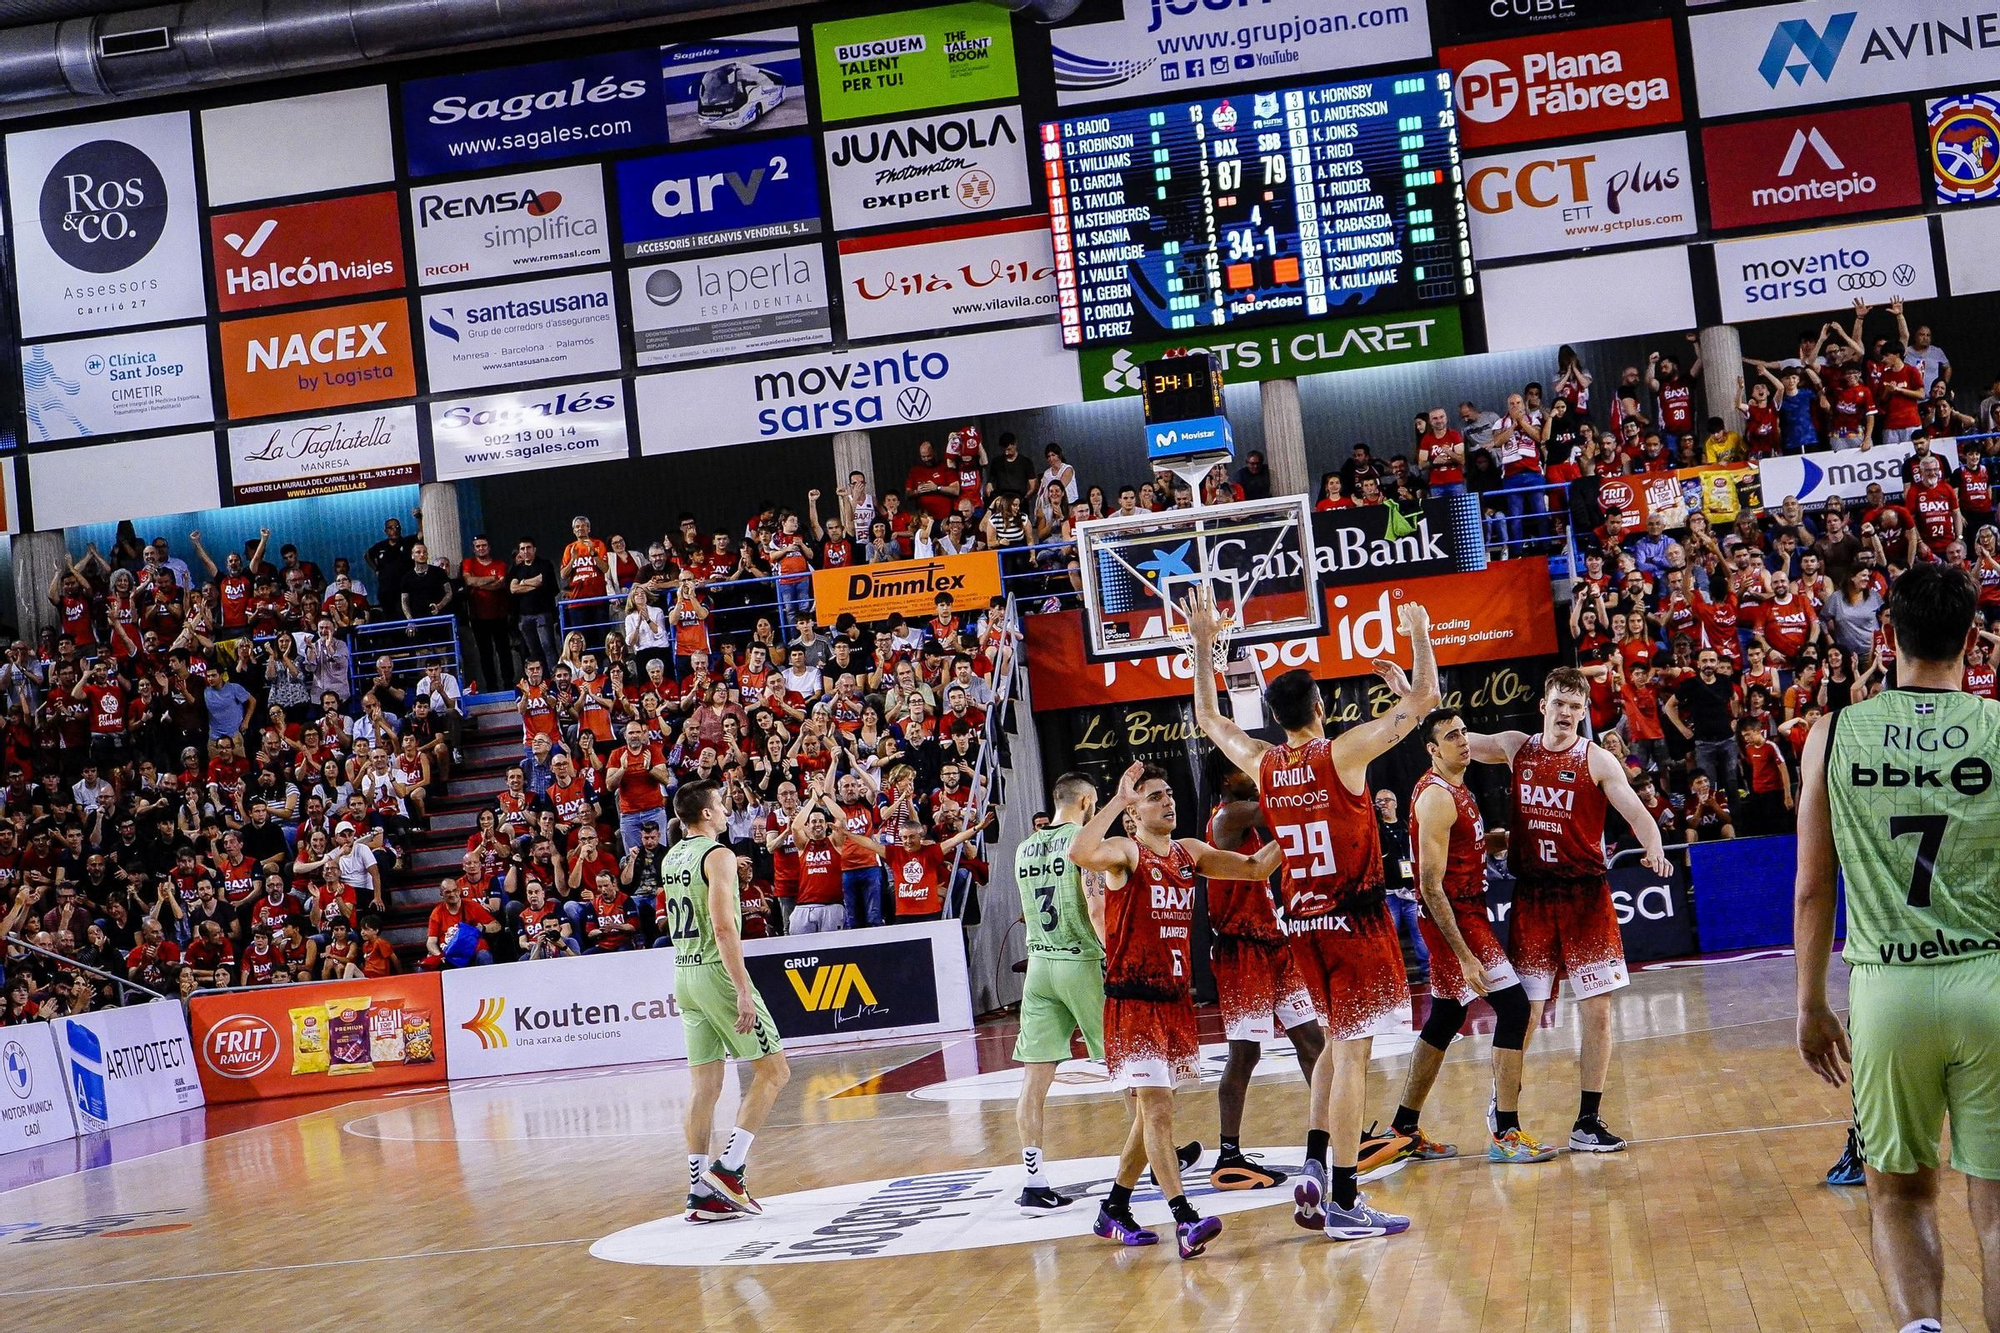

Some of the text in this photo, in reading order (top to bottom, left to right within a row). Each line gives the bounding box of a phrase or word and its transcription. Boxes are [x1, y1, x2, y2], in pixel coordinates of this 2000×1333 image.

[1530, 13, 1556, 21] fitness
[944, 31, 967, 42] THE
[1157, 5, 1409, 55] www.grupjoan.com
[1860, 12, 2000, 65] AVINE
[839, 37, 923, 61] BUSQUEM
[945, 38, 989, 52] TALENT
[948, 48, 988, 63] ROOM
[840, 57, 899, 76] TALENT
[1256, 50, 1299, 67] YouTube
[1523, 49, 1622, 84] Plana
[843, 72, 904, 93] PER TU!
[429, 75, 646, 124] Sagalés
[1309, 84, 1373, 105] K. HORNSBY
[1311, 101, 1388, 123] D. ANDERSSON
[449, 118, 632, 157] www.sagales.com
[1064, 118, 1110, 137] B. BADIO
[832, 114, 1016, 167] JUANOLA
[1067, 133, 1134, 156] D. ROBINSON
[1214, 138, 1239, 158] BAX
[1257, 133, 1282, 152] SBB
[875, 156, 977, 185] Photomaton
[1218, 160, 1242, 191] 87
[1260, 154, 1287, 185] 79
[62, 174, 144, 215] Ros
[1466, 154, 1680, 216] GCT plus
[1752, 172, 1876, 208] montepio
[420, 188, 547, 228] REMSA
[863, 184, 950, 210] expert
[1321, 195, 1384, 216] M. PANTZAR
[1563, 205, 1593, 222] ETT
[1565, 212, 1683, 238] www.gctplus.com
[484, 214, 598, 249] simplifica
[637, 237, 690, 254] ACCESSORIS
[697, 229, 742, 247] RECANVIS
[744, 225, 791, 241] VENDRELL,
[794, 222, 809, 234] S.L.
[513, 247, 601, 265] www.remsasl.com
[1078, 244, 1145, 265] S. MAWUGBE
[1327, 250, 1403, 271] TSALMPOURIS
[1742, 247, 1870, 282] movento
[227, 257, 393, 294] Halcón viajes
[425, 262, 469, 277] RICOH
[64, 278, 158, 299] Assessors
[1745, 276, 1827, 303] sarsa
[78, 300, 147, 315] Carrió 27
[466, 291, 609, 325] santasusana
[1084, 302, 1134, 321] P. ORIOLA
[467, 313, 610, 339] Grup de corredors d'assegurances
[247, 323, 388, 373] NACEX
[452, 337, 594, 362] Manresa Barcelona Palamós
[1271, 319, 1435, 364] i CLARET
[109, 352, 156, 367] Clínica
[482, 353, 568, 371] www.santasusana.com
[110, 364, 184, 381] Sant Josep
[298, 375, 318, 390] by
[755, 349, 949, 402] movento
[1154, 373, 1192, 394] 34:1
[112, 385, 162, 401] CIMETIR
[759, 394, 883, 436] sarsa
[244, 416, 392, 461] La Tagliatella
[484, 426, 576, 447] 902 13 00 14
[1181, 430, 1215, 440] Movistar
[464, 436, 600, 464] www.sagales.com
[301, 460, 350, 472] MANRESA
[240, 485, 263, 495] CARRER
[282, 480, 310, 489] MURALLA
[312, 478, 322, 486] DEL
[287, 482, 367, 498] WWW.LATAGLIATELLA.ES
[1602, 487, 1627, 500] FRIT
[1919, 501, 1949, 512] BAXI
[1932, 525, 1944, 536] 24
[1336, 590, 1395, 661] id
[1437, 619, 1470, 631] coding
[1469, 629, 1514, 642] solutions
[1471, 668, 1535, 707] d'Or
[1074, 711, 1208, 751] La Bruix
[1883, 724, 1969, 752] RIGO
[1273, 765, 1315, 788] ORIOLA
[1852, 763, 1943, 788] bbk
[1520, 783, 1575, 812] BAXI
[1275, 820, 1337, 879] 29
[1538, 838, 1558, 863] 12
[1890, 814, 1948, 908] 7
[668, 896, 700, 939] 22
[1035, 886, 1058, 932] 3
[784, 956, 820, 970] GRUP
[1581, 973, 1599, 984] ETL
[1583, 978, 1613, 993] GLOBAL
[514, 992, 680, 1032] Kouten.cat
[215, 1028, 267, 1053] FRIT
[516, 1029, 621, 1047] Una xarxa de solucions
[105, 1037, 187, 1081] ARTIPOTECT
[220, 1049, 261, 1065] RAVICH
[1, 1100, 53, 1121] MOTOR MUNICH
[24, 1120, 41, 1136] CADÍ
